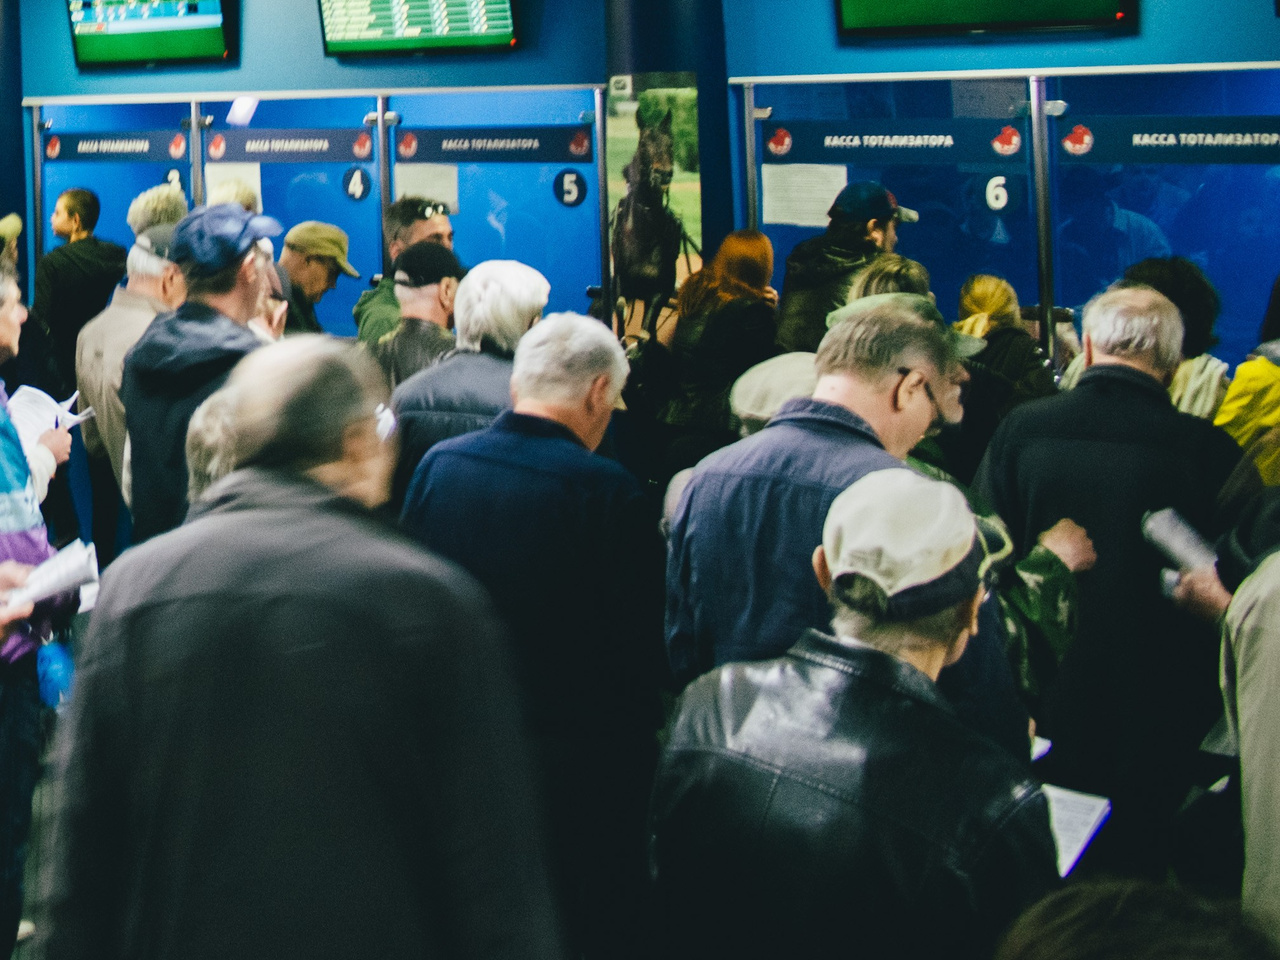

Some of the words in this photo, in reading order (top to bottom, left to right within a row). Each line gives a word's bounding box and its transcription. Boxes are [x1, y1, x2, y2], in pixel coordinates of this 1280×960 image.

[442, 139, 469, 150] КАССА
[470, 139, 539, 150] ТОТАЛИЗАТОРА
[824, 136, 860, 147] КАССА
[863, 135, 953, 147] ТОТАЛИЗАТОРА
[1133, 133, 1177, 147] КАССА
[1180, 132, 1280, 146] ТОТАЛИЗАТОР
[348, 169, 363, 199] 4
[563, 173, 579, 203] 5
[986, 176, 1008, 210] 6
